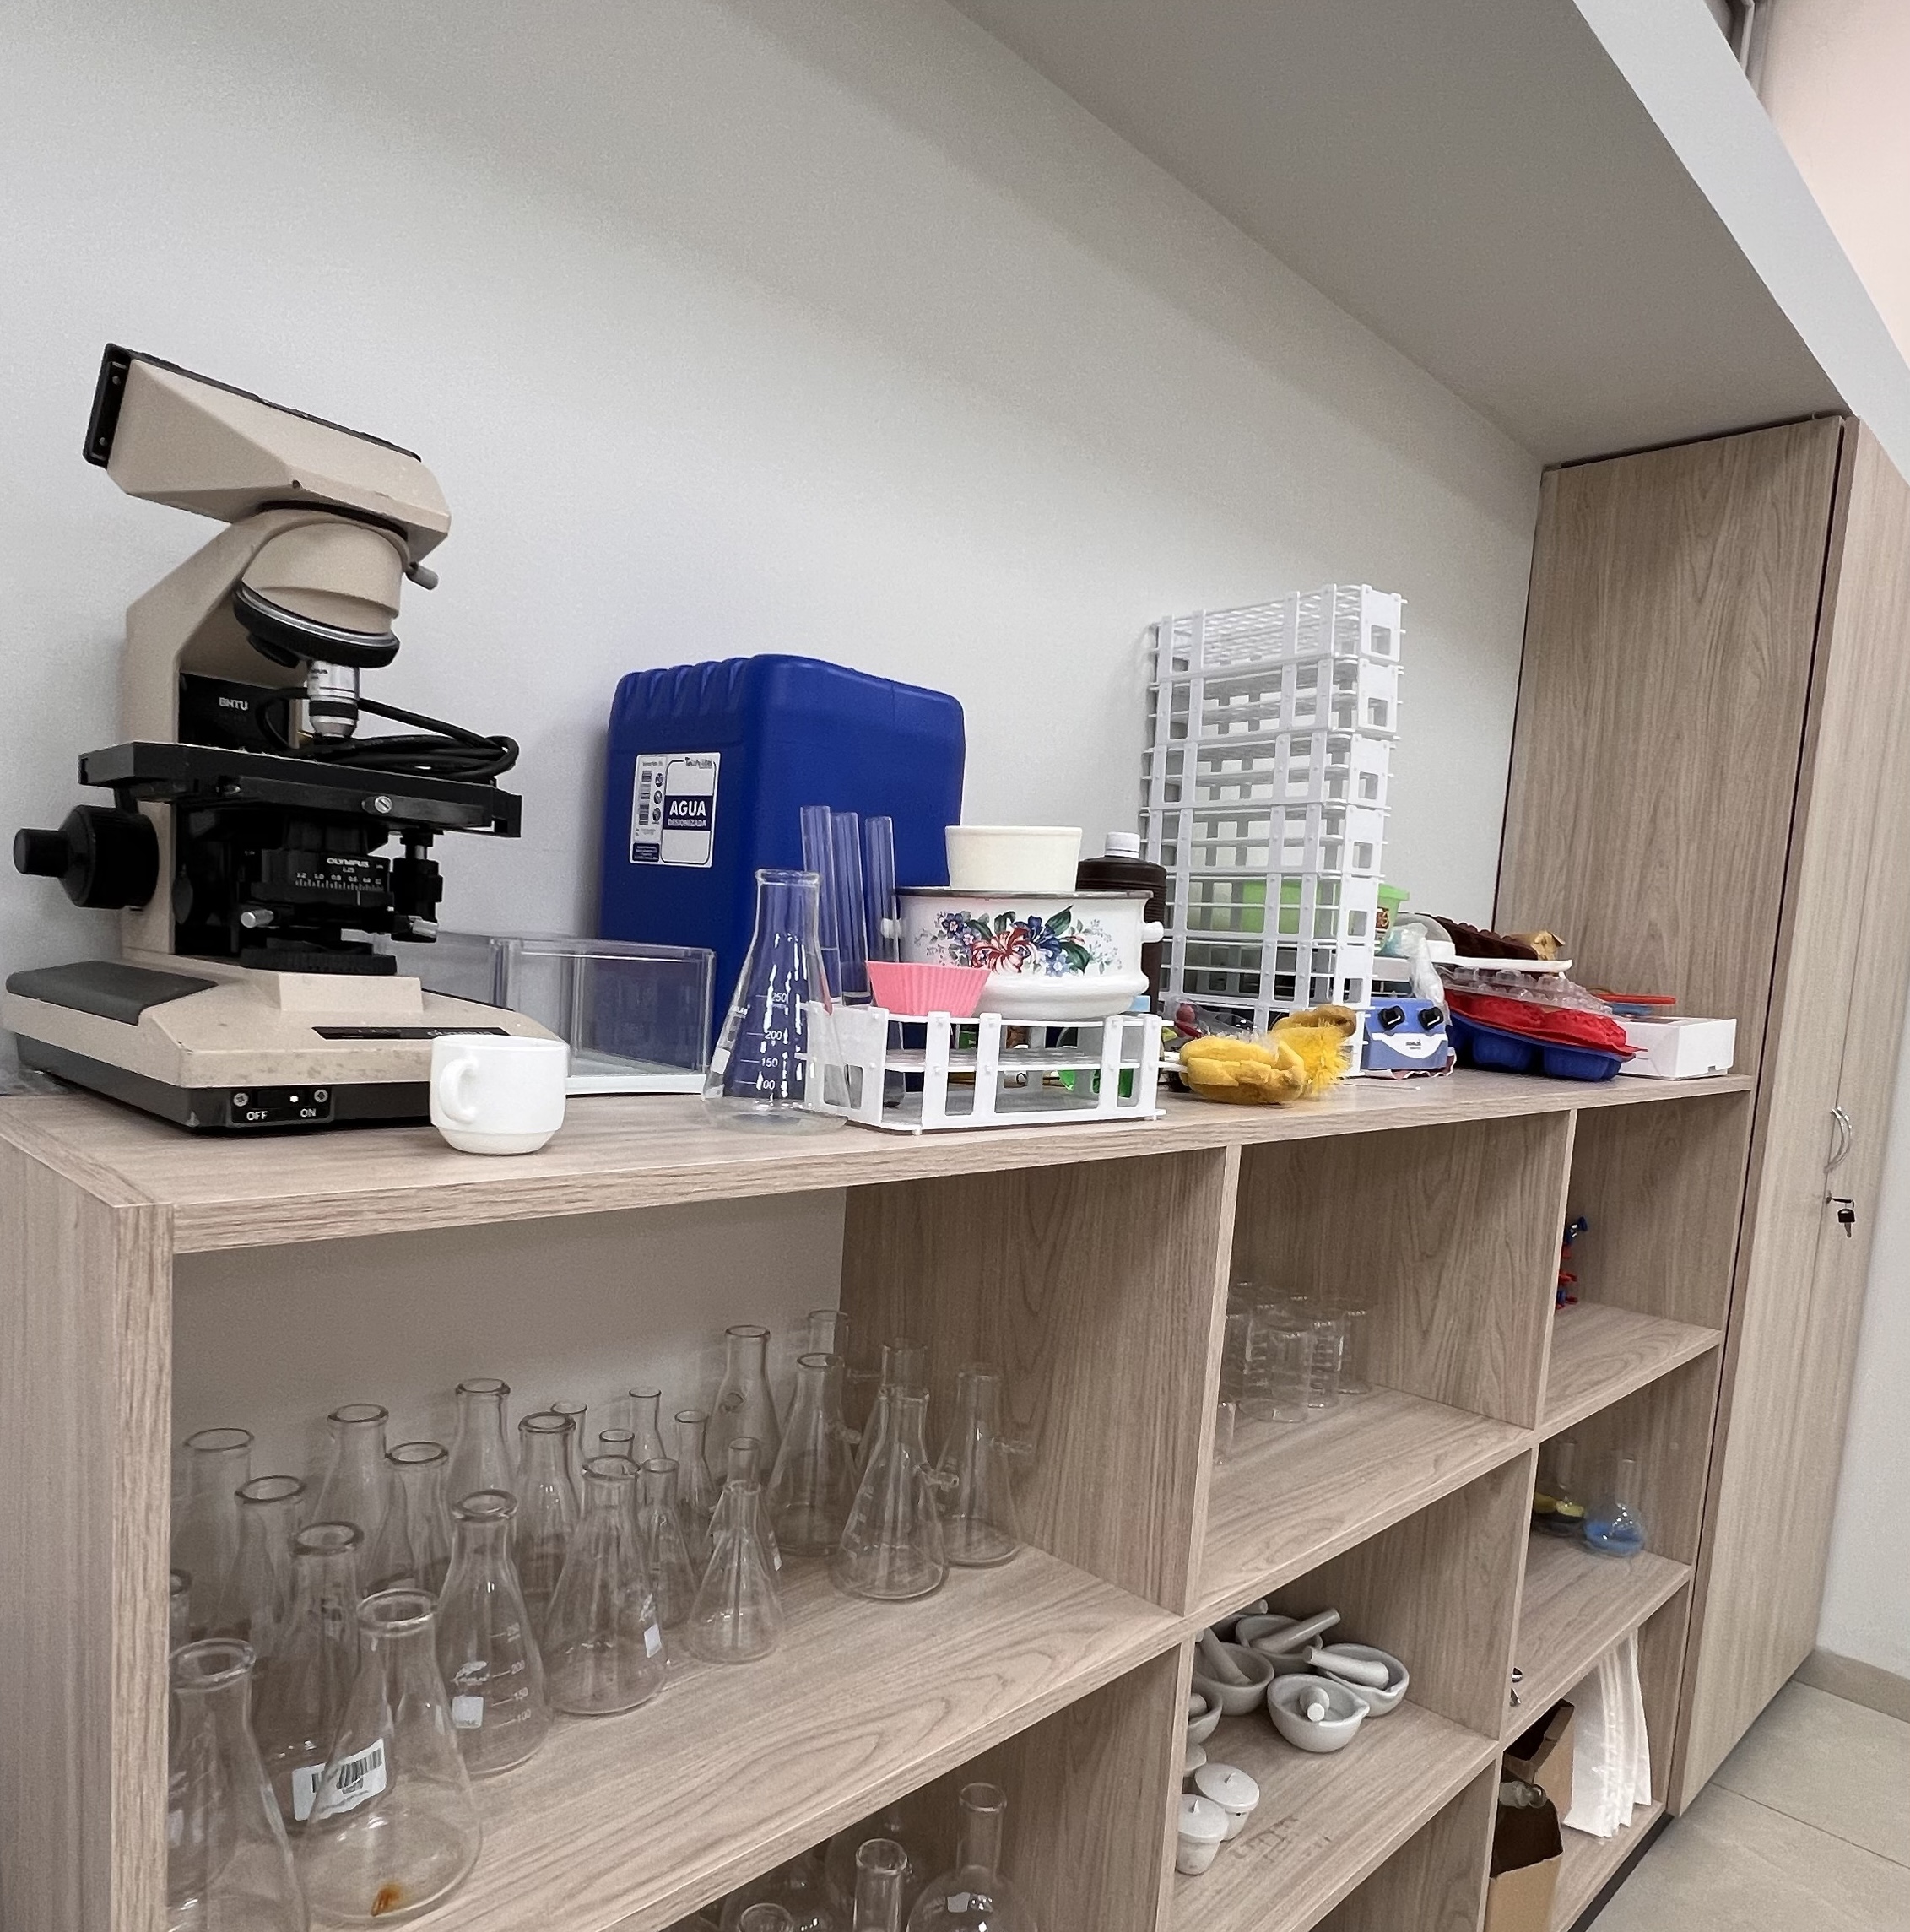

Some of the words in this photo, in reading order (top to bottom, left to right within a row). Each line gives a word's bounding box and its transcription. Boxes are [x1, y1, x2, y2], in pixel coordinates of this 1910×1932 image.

[669, 800, 706, 816] AGUA
[327, 858, 370, 868] OLYMPUS
[772, 992, 787, 1003] 250
[765, 1030, 782, 1041] 200
[761, 1057, 779, 1068] 150
[758, 1080, 776, 1090] 00
[246, 1111, 268, 1121] OFF
[300, 1108, 317, 1118] ON
